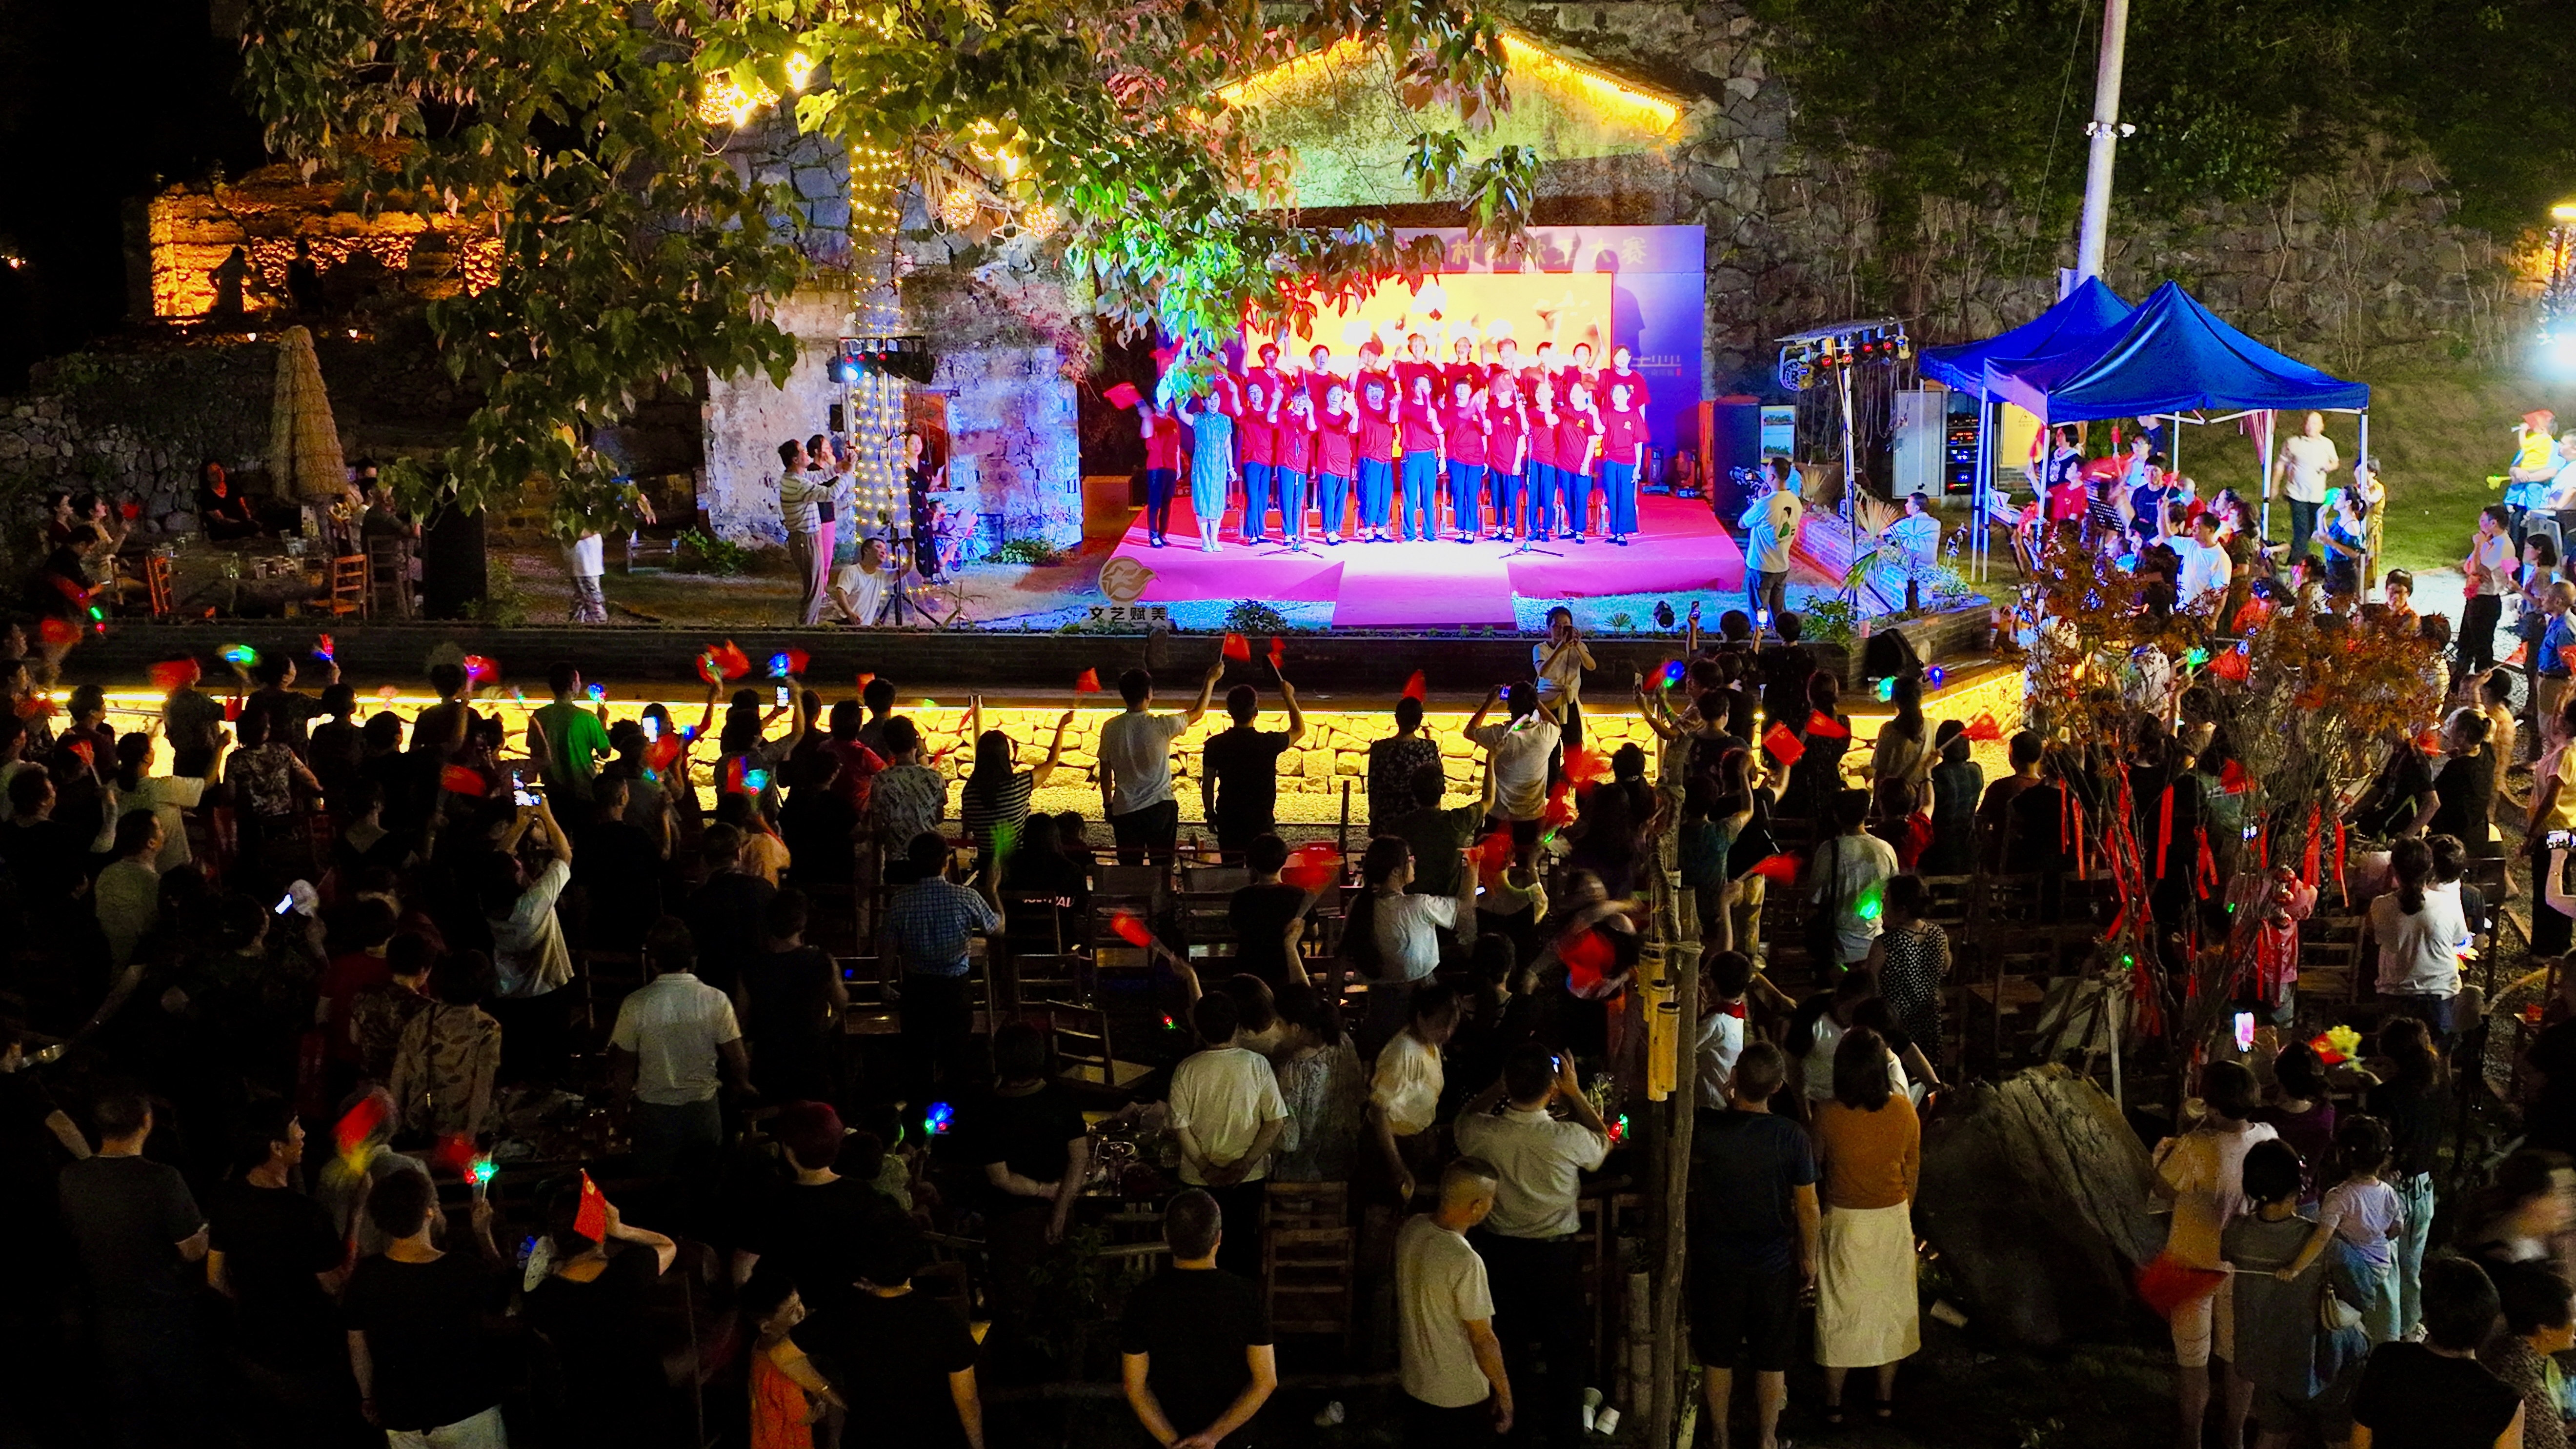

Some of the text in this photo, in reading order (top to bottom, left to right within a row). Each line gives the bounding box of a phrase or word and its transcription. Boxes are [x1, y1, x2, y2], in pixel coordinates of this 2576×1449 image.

[1451, 237, 1647, 265] 村王大赛
[1089, 606, 1167, 621] 文艺赋美
